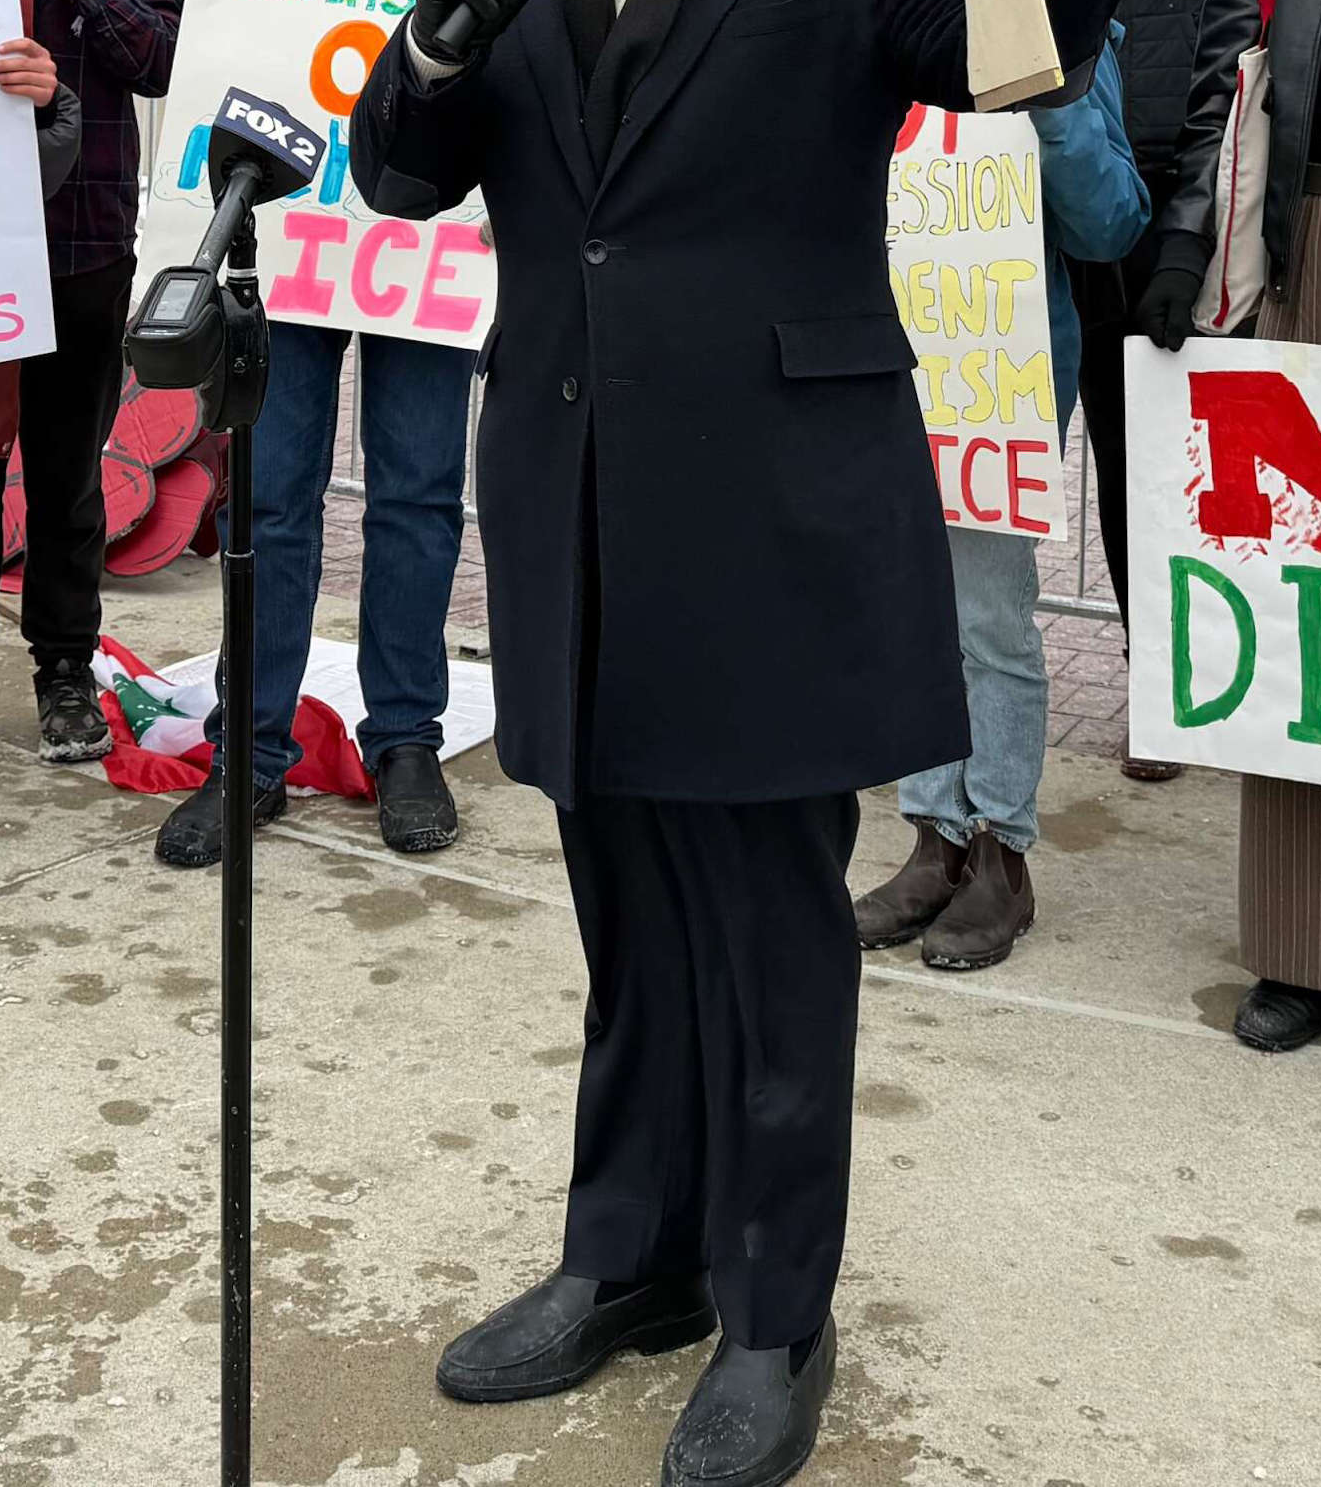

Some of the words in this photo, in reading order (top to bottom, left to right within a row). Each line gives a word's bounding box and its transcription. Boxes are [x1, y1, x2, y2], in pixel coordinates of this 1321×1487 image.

[226, 98, 295, 149] FOX
[290, 136, 318, 167] 2
[265, 211, 492, 333] ICE
[911, 348, 1056, 426] ISM
